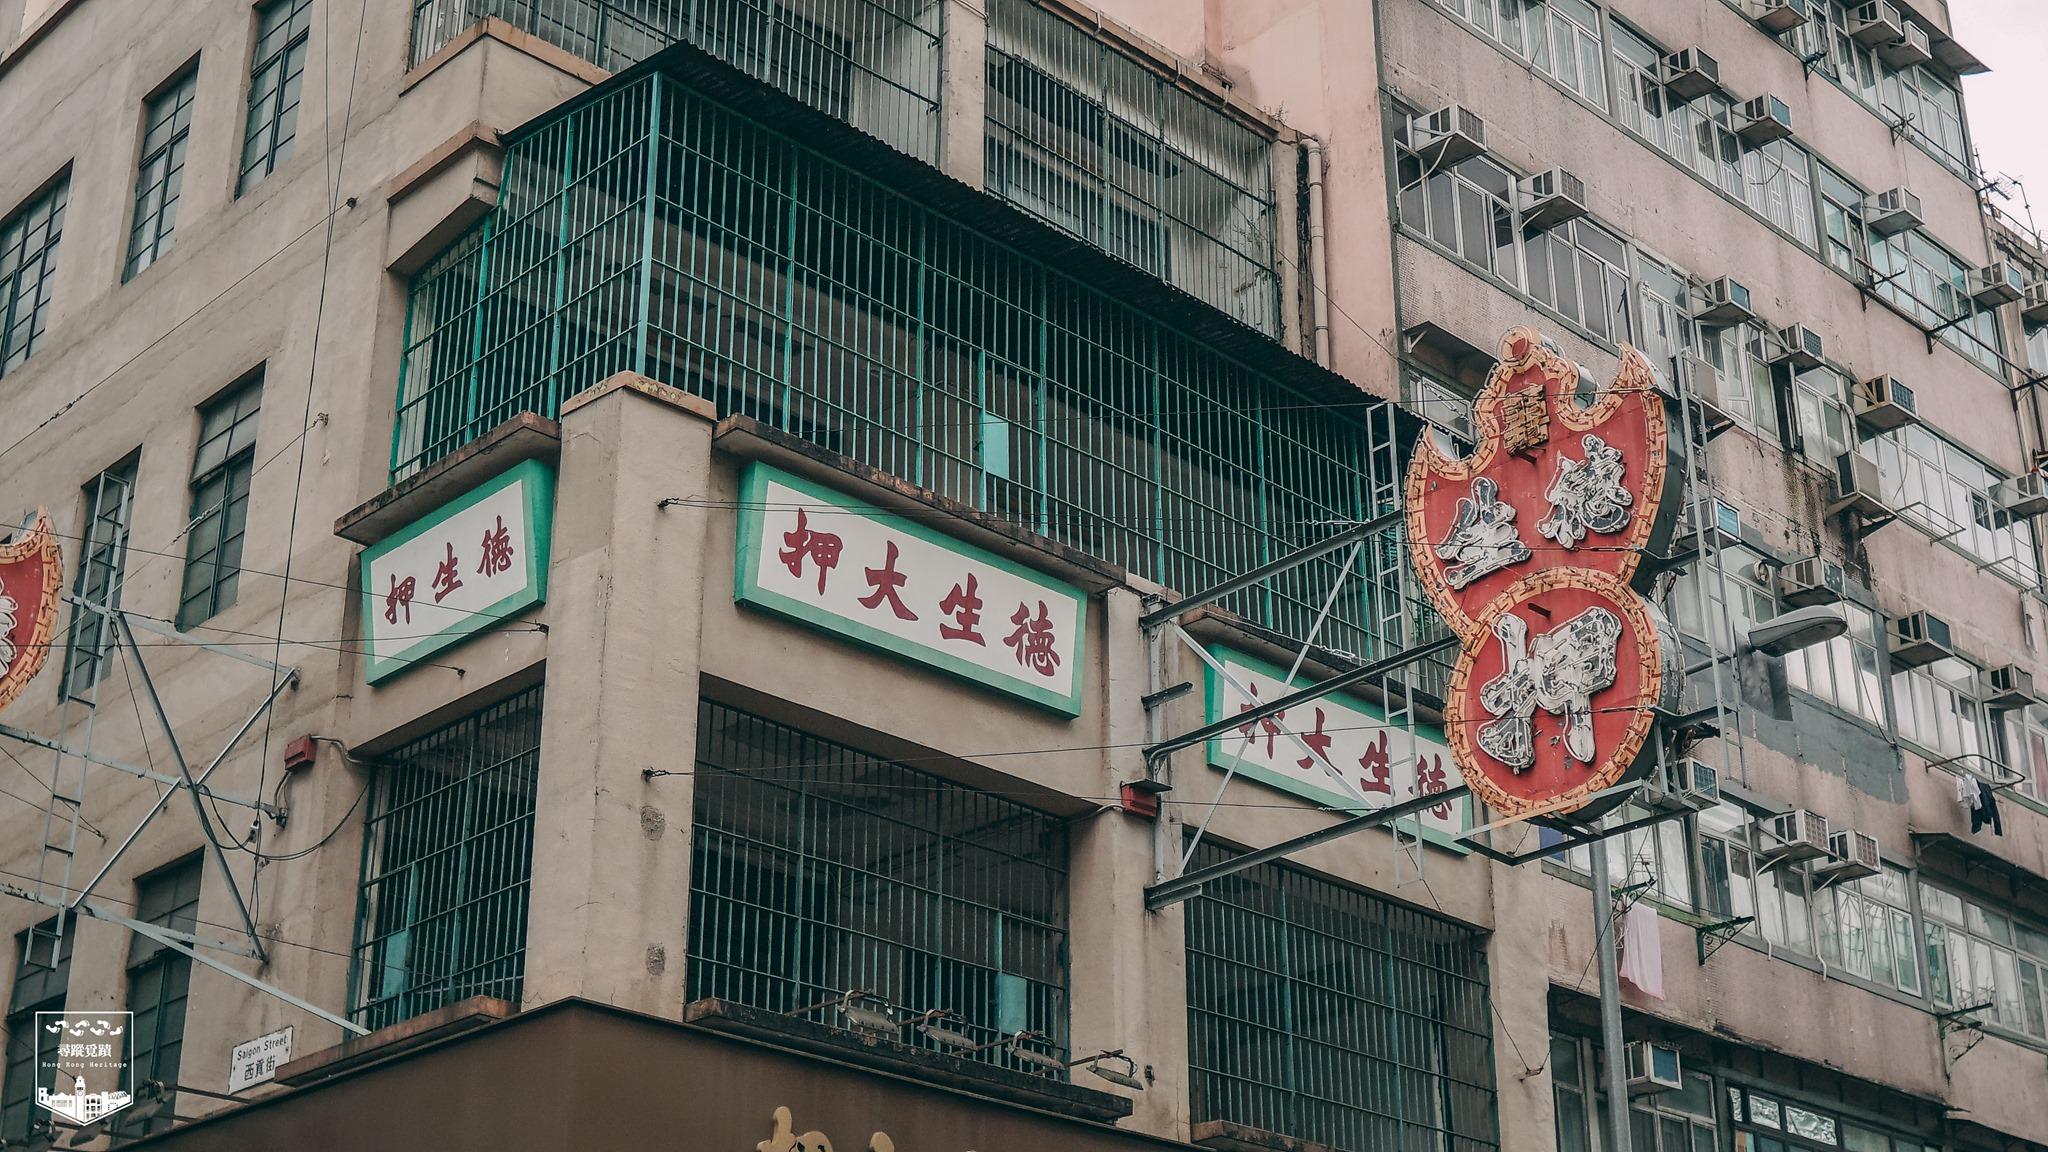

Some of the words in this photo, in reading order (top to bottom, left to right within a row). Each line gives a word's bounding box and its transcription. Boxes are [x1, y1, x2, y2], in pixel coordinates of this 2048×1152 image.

[237, 1046, 261, 1061] Saigon
[264, 1034, 287, 1051] Street
[244, 1054, 276, 1081] 西貢街
